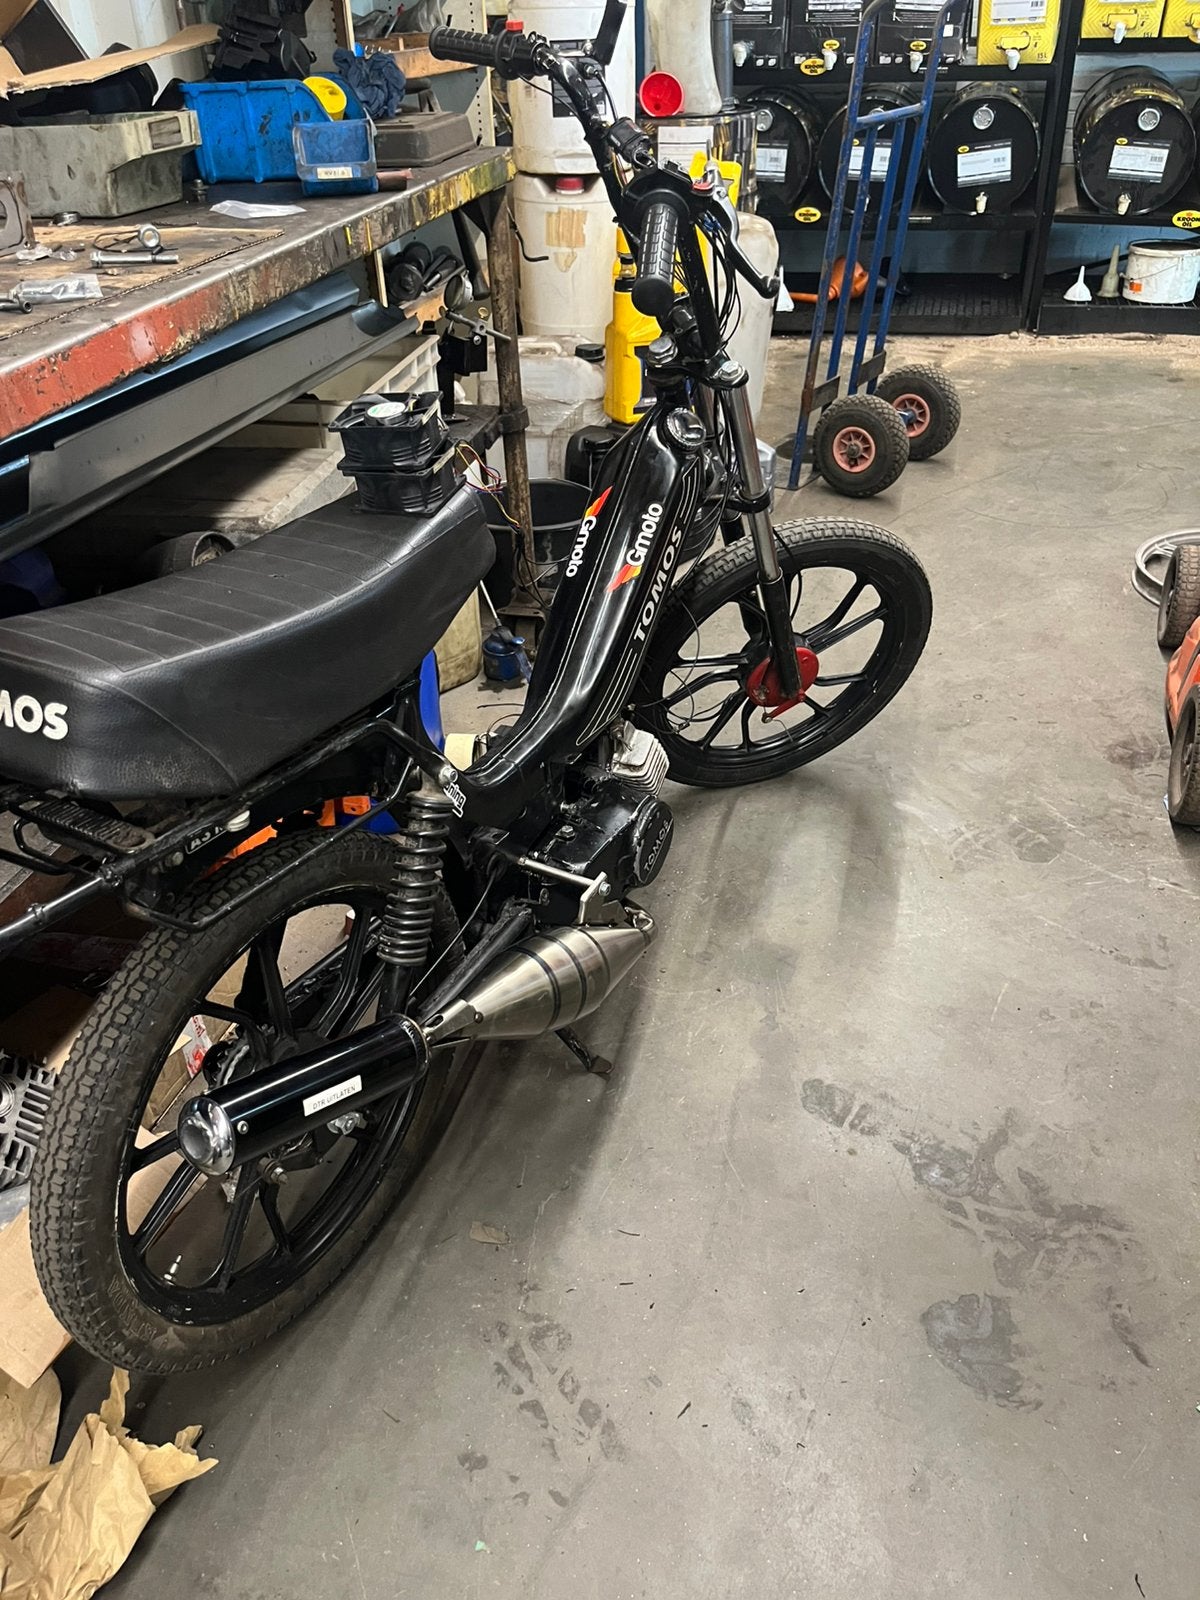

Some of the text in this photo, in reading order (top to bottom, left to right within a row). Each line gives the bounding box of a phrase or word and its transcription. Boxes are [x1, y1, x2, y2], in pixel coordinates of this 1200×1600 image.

[565, 515, 597, 578] Gmoto
[626, 503, 663, 566] Gmoto
[633, 526, 682, 642] TOMOS
[643, 819, 670, 871] TOMOS
[327, 1085, 356, 1103] UITLATEN
